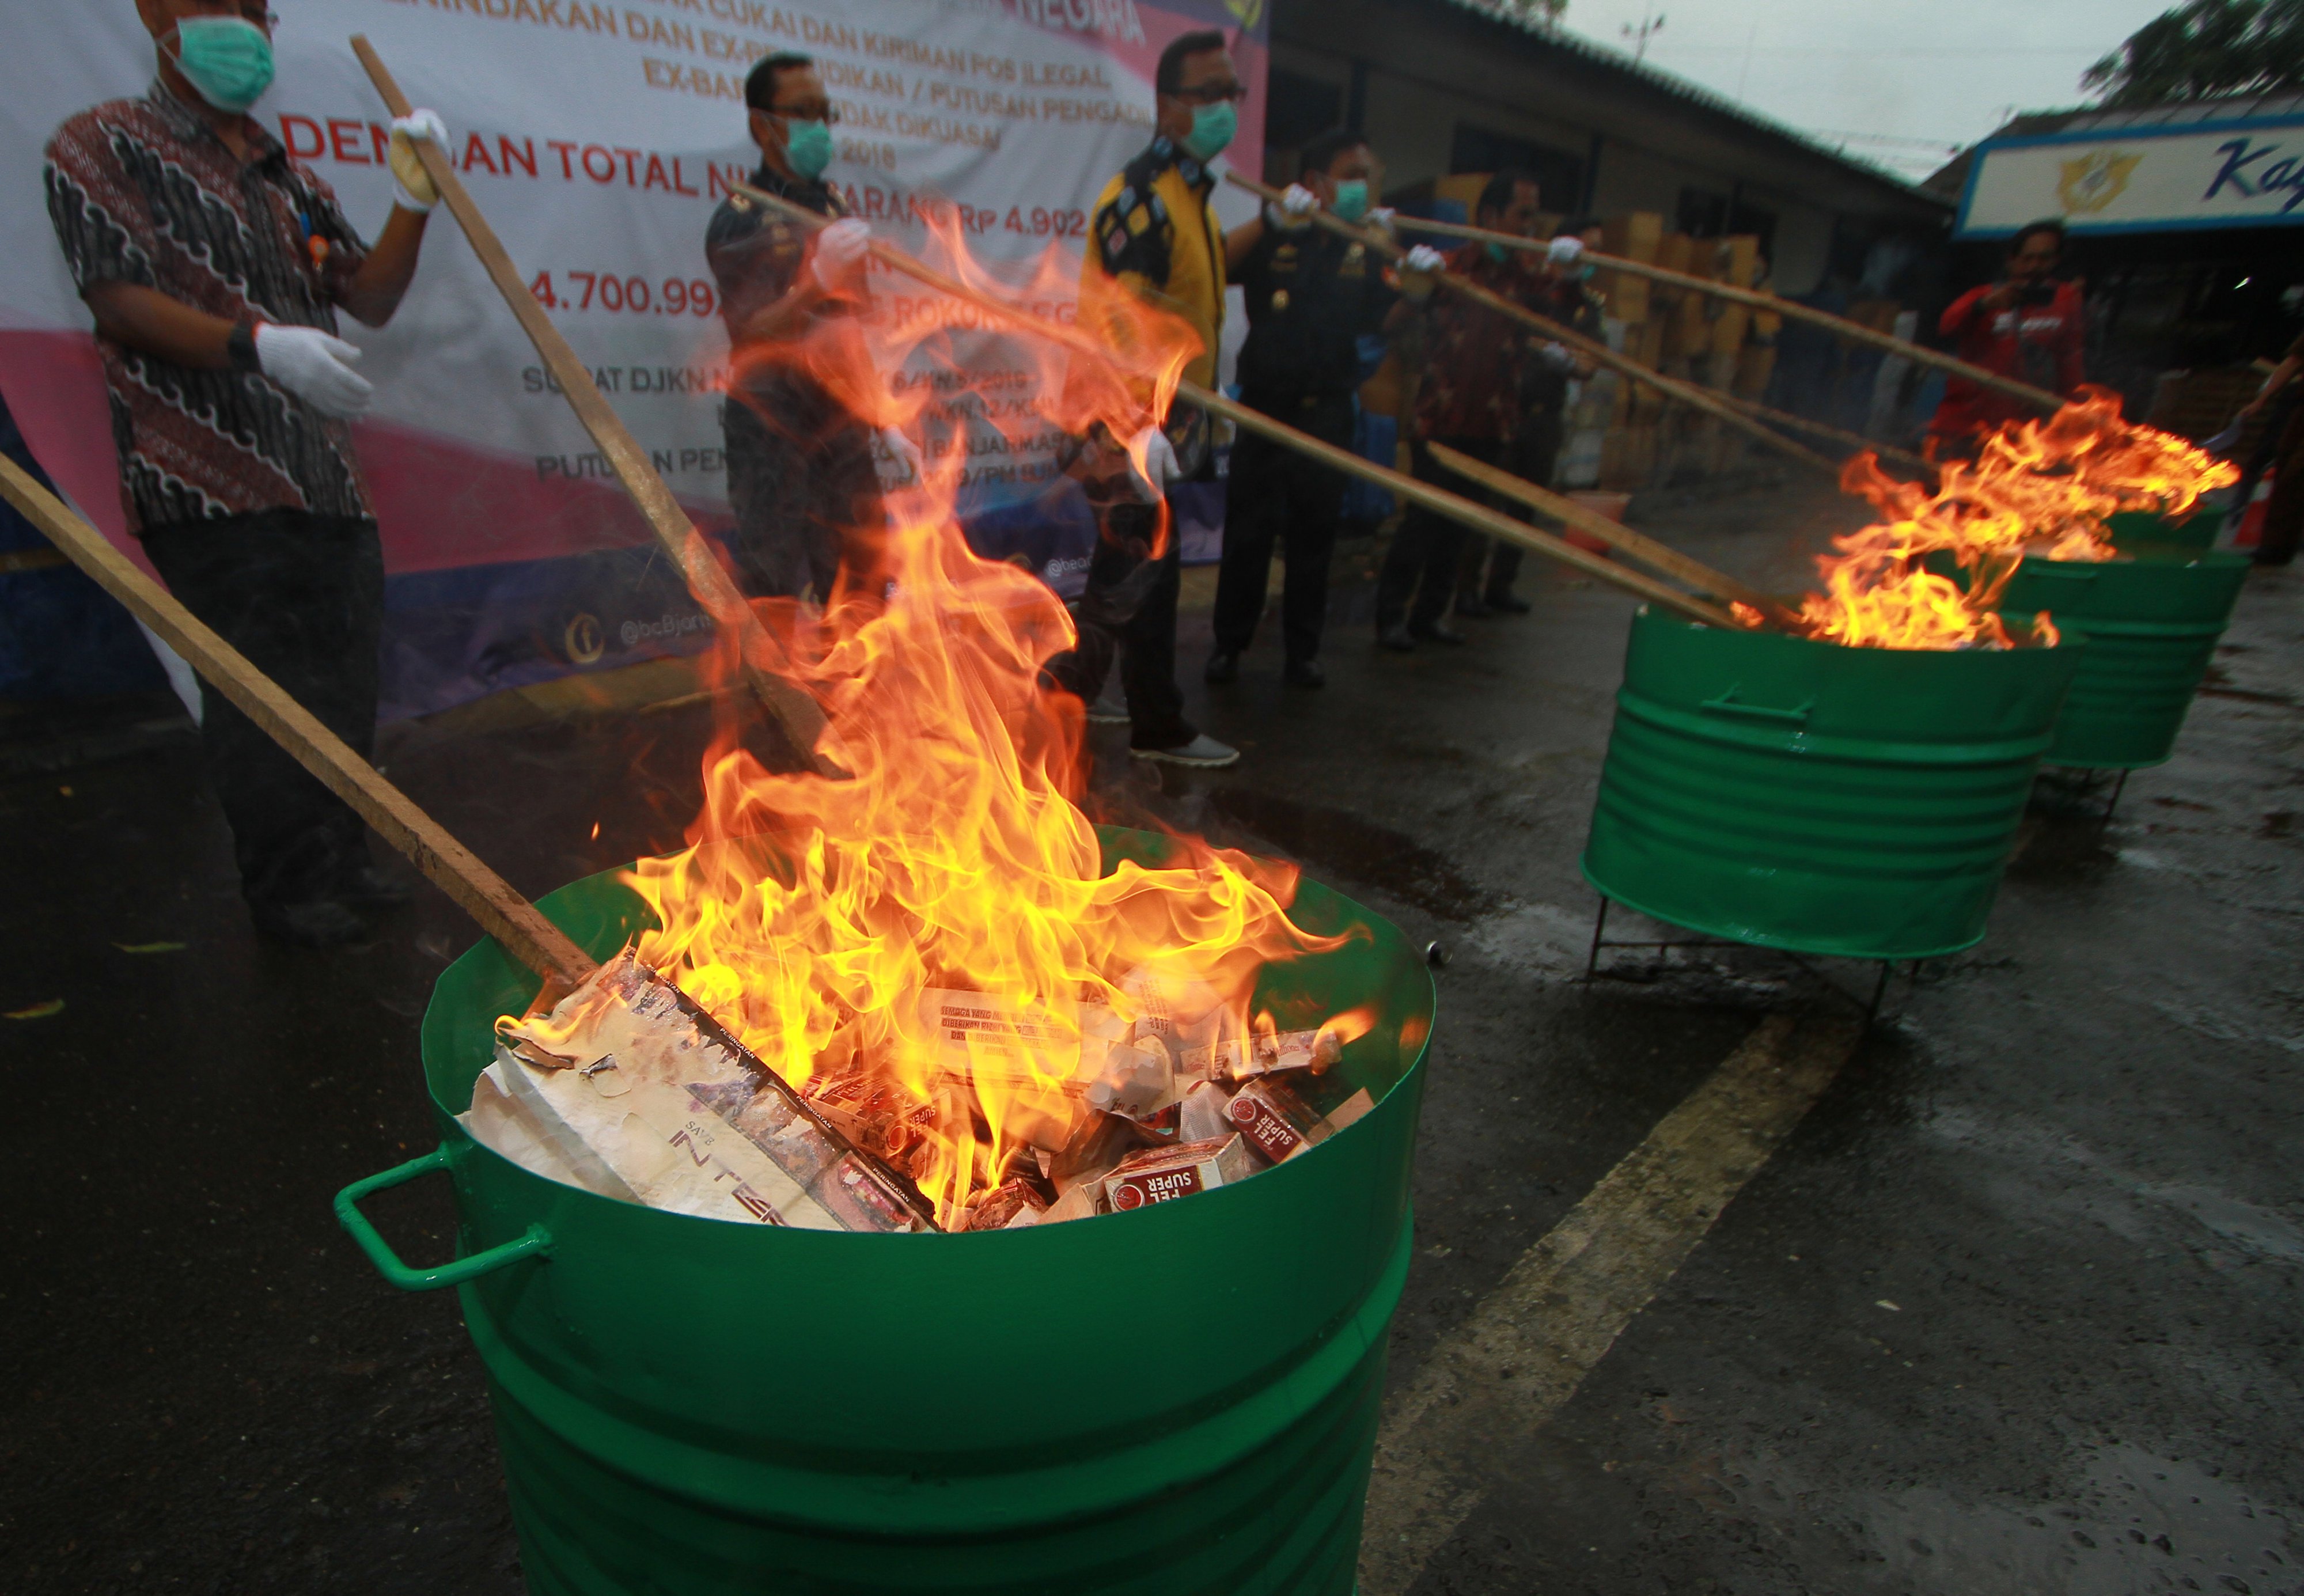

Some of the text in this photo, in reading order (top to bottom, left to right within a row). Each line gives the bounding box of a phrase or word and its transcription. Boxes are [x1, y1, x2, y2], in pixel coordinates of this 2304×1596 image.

[708, 0, 797, 37] CUKAI
[802, 15, 859, 52] DAN
[864, 30, 968, 75] KIRIMAN
[971, 52, 1017, 82] POS
[1022, 60, 1113, 92] ILEGAL
[625, 9, 695, 52] DAN
[929, 81, 1036, 121] PUTUSAN
[278, 112, 539, 179] DENAN
[547, 139, 699, 198] TOTAL
[841, 135, 897, 170] 2018
[521, 366, 622, 394] SUAT
[630, 367, 707, 393] DJKN
[535, 448, 673, 482] PUTUN
[941, 1006, 971, 1018] SEMOGA
[971, 1008, 992, 1020] YANG
[941, 1018, 980, 1030] DIBERIKAN
[719, 1028, 756, 1060] PERINGATAN
[951, 1030, 966, 1041] DAN
[795, 1095, 832, 1129] PERINGATAN
[910, 1105, 937, 1128] SUPER
[685, 1121, 715, 1147] SAVE
[1253, 1122, 1275, 1146] FEL
[1260, 1113, 1294, 1146] SUPER
[871, 1166, 911, 1203] PERINGATAN
[1146, 1171, 1192, 1192] SUPER
[1150, 1188, 1181, 1204] FEL
